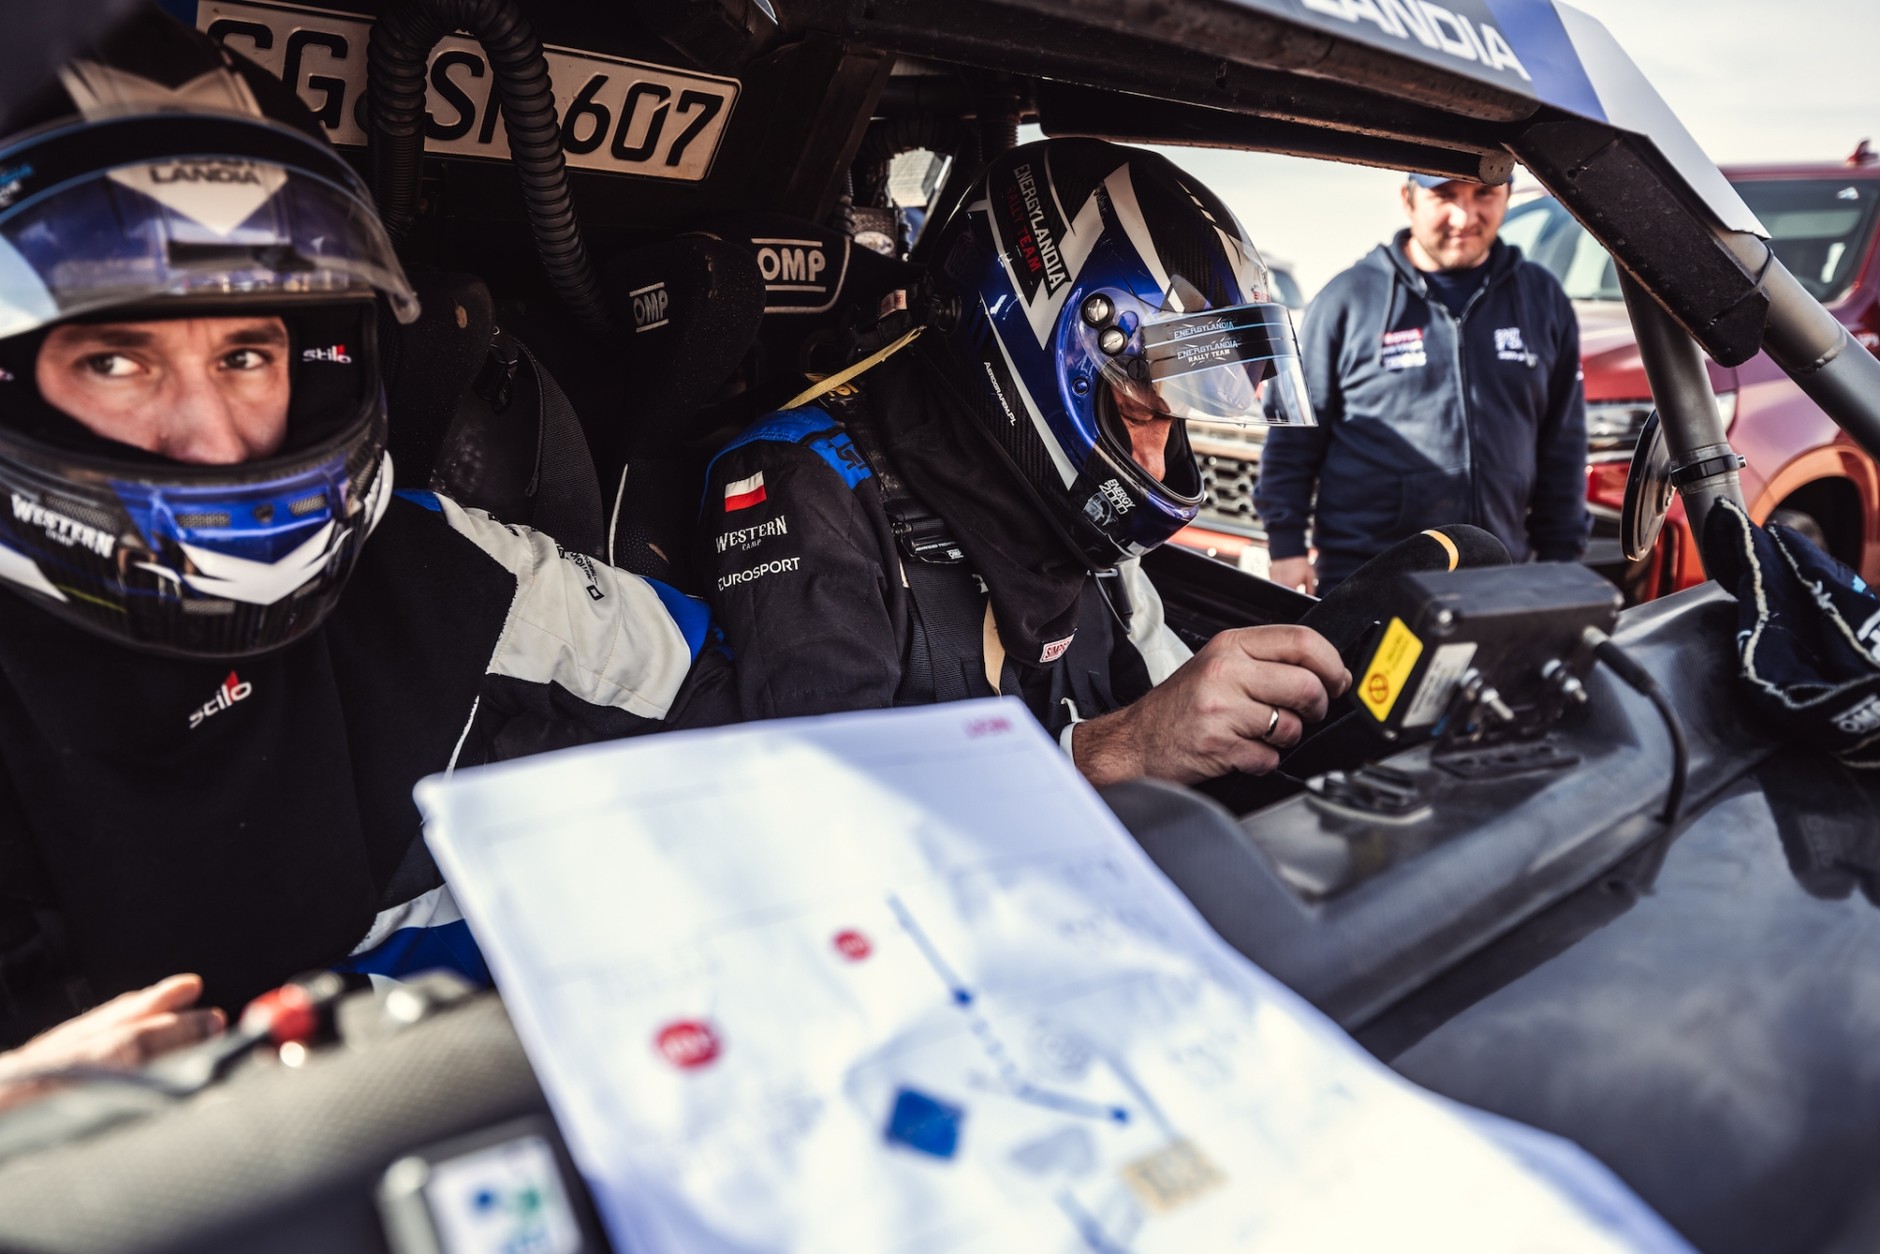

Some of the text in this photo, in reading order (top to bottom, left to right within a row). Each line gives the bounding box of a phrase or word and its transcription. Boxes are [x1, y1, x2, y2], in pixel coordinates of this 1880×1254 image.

[1013, 163, 1066, 290] ENERGYLANDIA
[757, 247, 826, 282] OMP
[1017, 225, 1042, 273] TEAM
[633, 289, 669, 325] OMP
[1173, 320, 1235, 341] ENERGYLANDIA
[1177, 339, 1239, 361] ENERGYLANDIA
[1188, 348, 1231, 364] RALLY TEAM
[1099, 482, 1128, 515] 2000
[1107, 478, 1136, 509] ENERGY
[11, 493, 116, 559] WESTERN
[715, 515, 788, 554] WESTERN
[742, 538, 762, 552] CAMP
[717, 557, 800, 592] EUROSPORT
